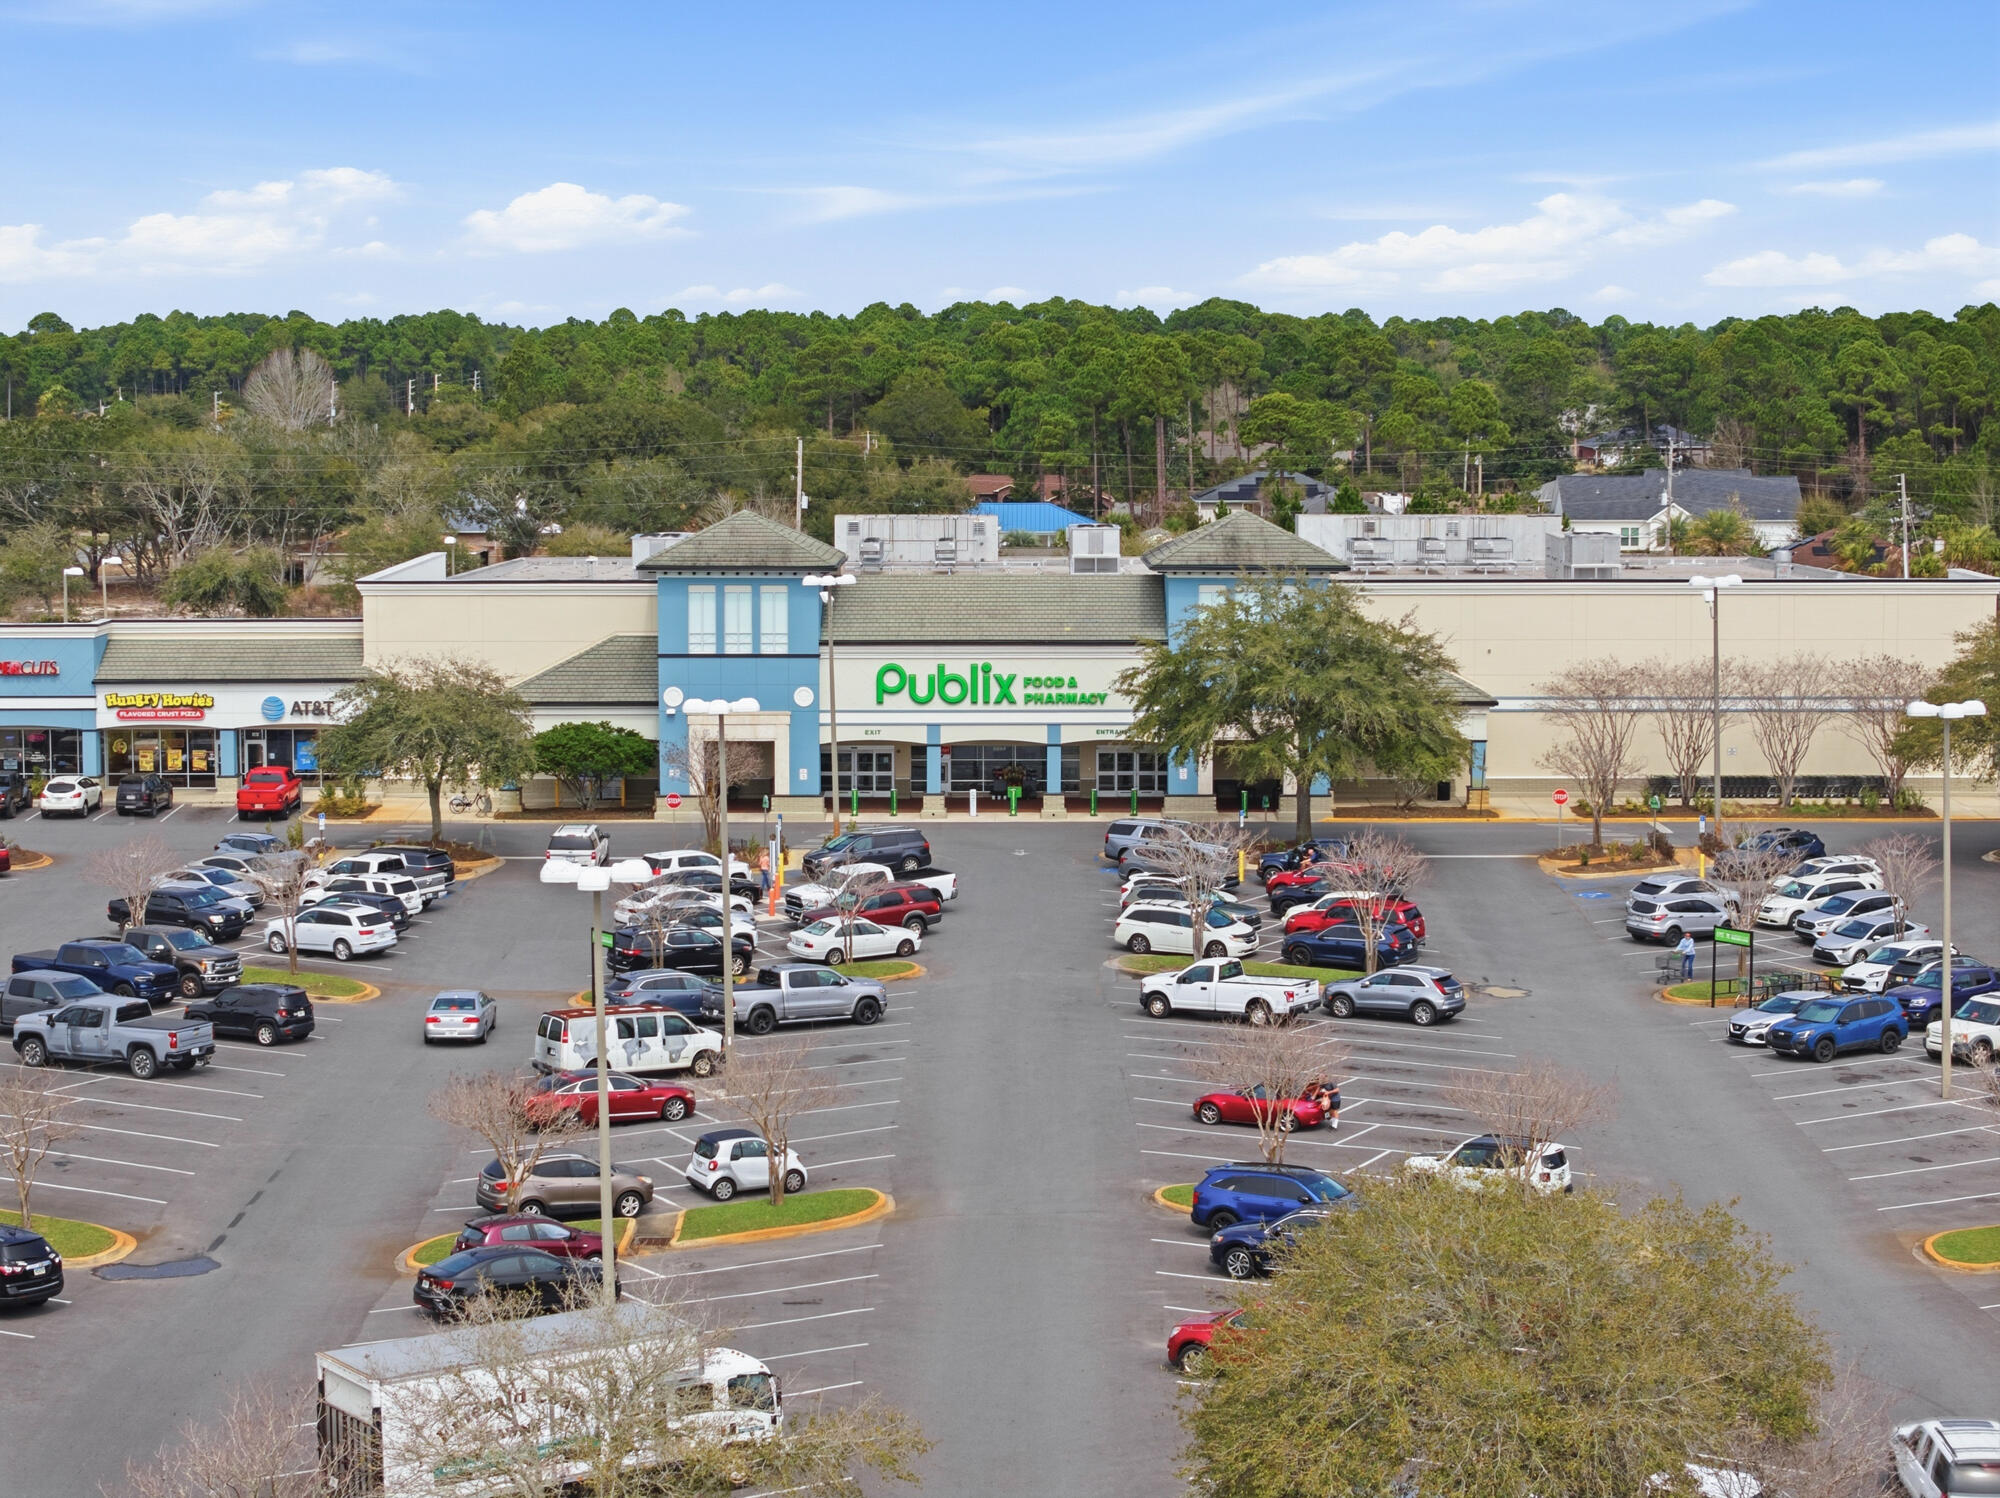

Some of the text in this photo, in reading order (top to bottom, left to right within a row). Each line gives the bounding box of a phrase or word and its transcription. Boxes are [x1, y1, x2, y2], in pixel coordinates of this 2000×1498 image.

[876, 662, 1017, 704] Publix
[1023, 676, 1078, 688] FOOD &
[105, 692, 215, 708] Hungry Howie's
[1024, 693, 1108, 704] PHARMACY
[290, 701, 335, 716] AT&T
[1553, 793, 1568, 801] STOP
